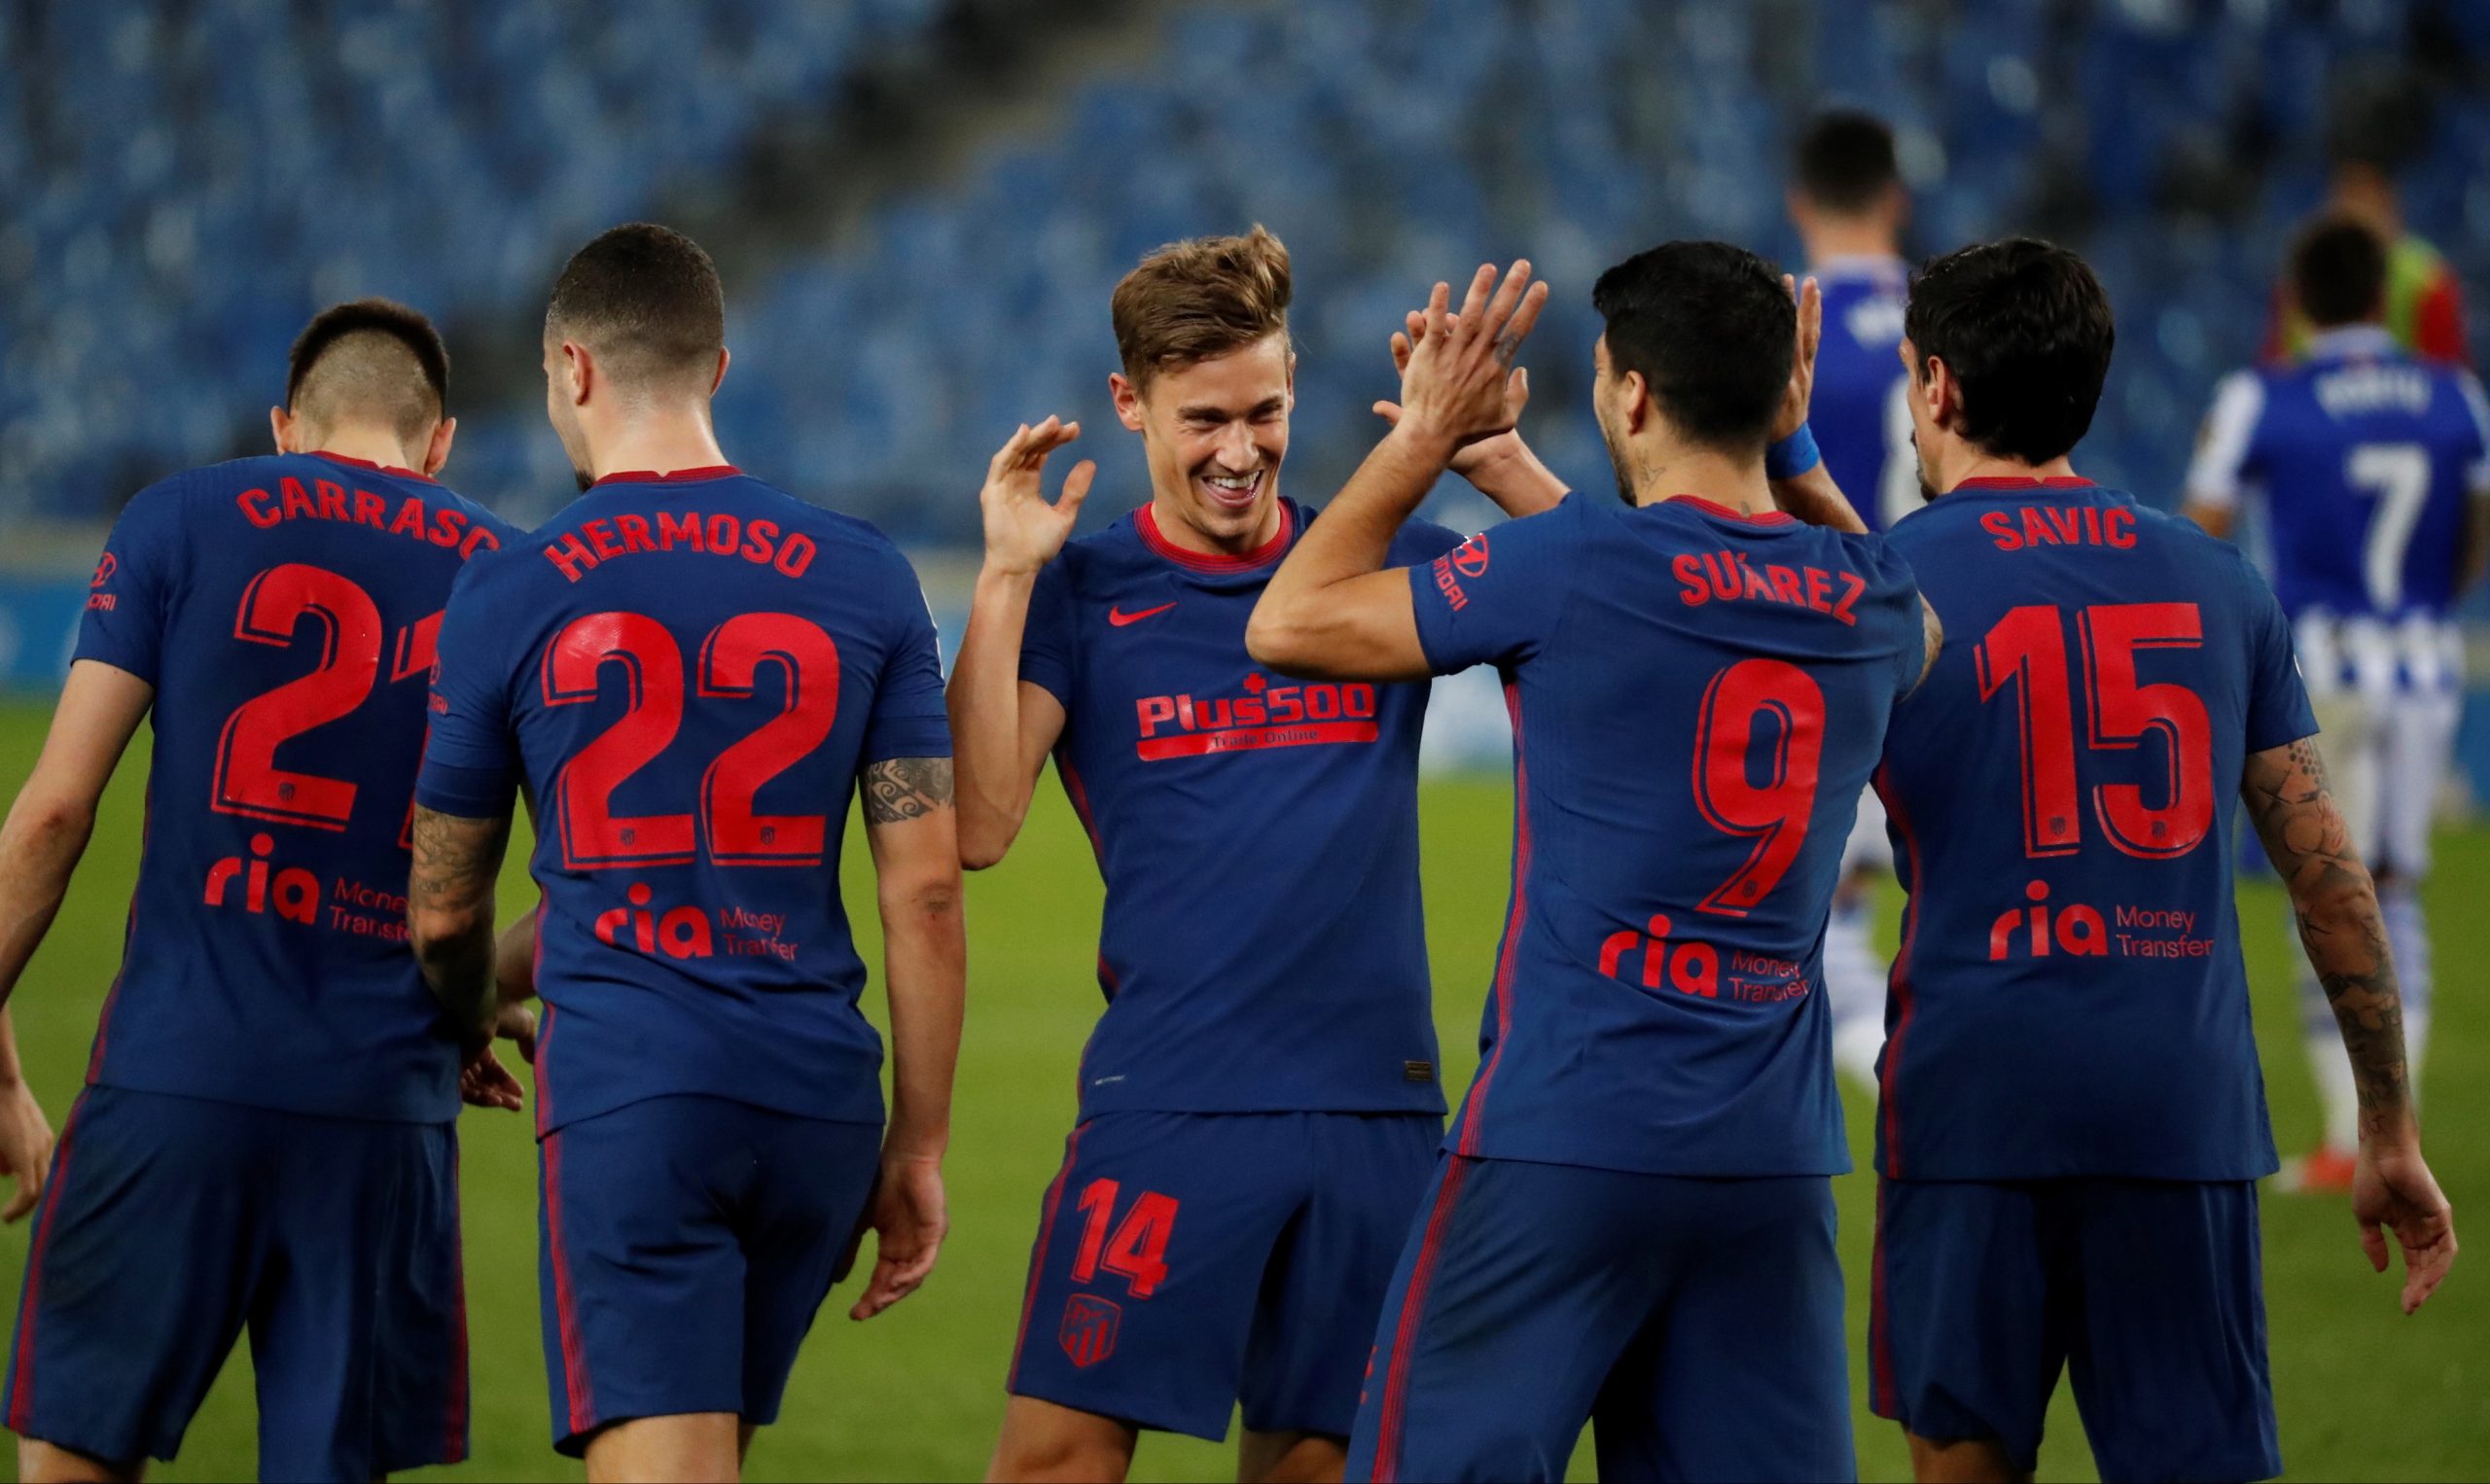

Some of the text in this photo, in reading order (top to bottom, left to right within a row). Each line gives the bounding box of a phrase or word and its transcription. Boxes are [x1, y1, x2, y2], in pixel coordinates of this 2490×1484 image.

[236, 476, 500, 561] CARRASC
[544, 512, 817, 583] HERMOSO
[2346, 443, 2431, 615] 7
[1672, 550, 1866, 626] SUÁREZ
[541, 612, 840, 870] 22
[1136, 682, 1375, 737] Plus500
[1214, 733, 1258, 748] Trade
[1264, 729, 1318, 744] Online
[1974, 603, 2214, 860] 15
[1691, 657, 1827, 918] 9
[204, 833, 320, 925] ria
[335, 876, 409, 913] Mone
[595, 883, 713, 959] ria
[1598, 914, 1719, 999] ria
[1989, 880, 2109, 961] ria
[2116, 904, 2195, 934] Money
[2116, 934, 2215, 958] Transfer
[1731, 950, 1801, 980] Money
[1071, 1178, 1180, 1300] 14
